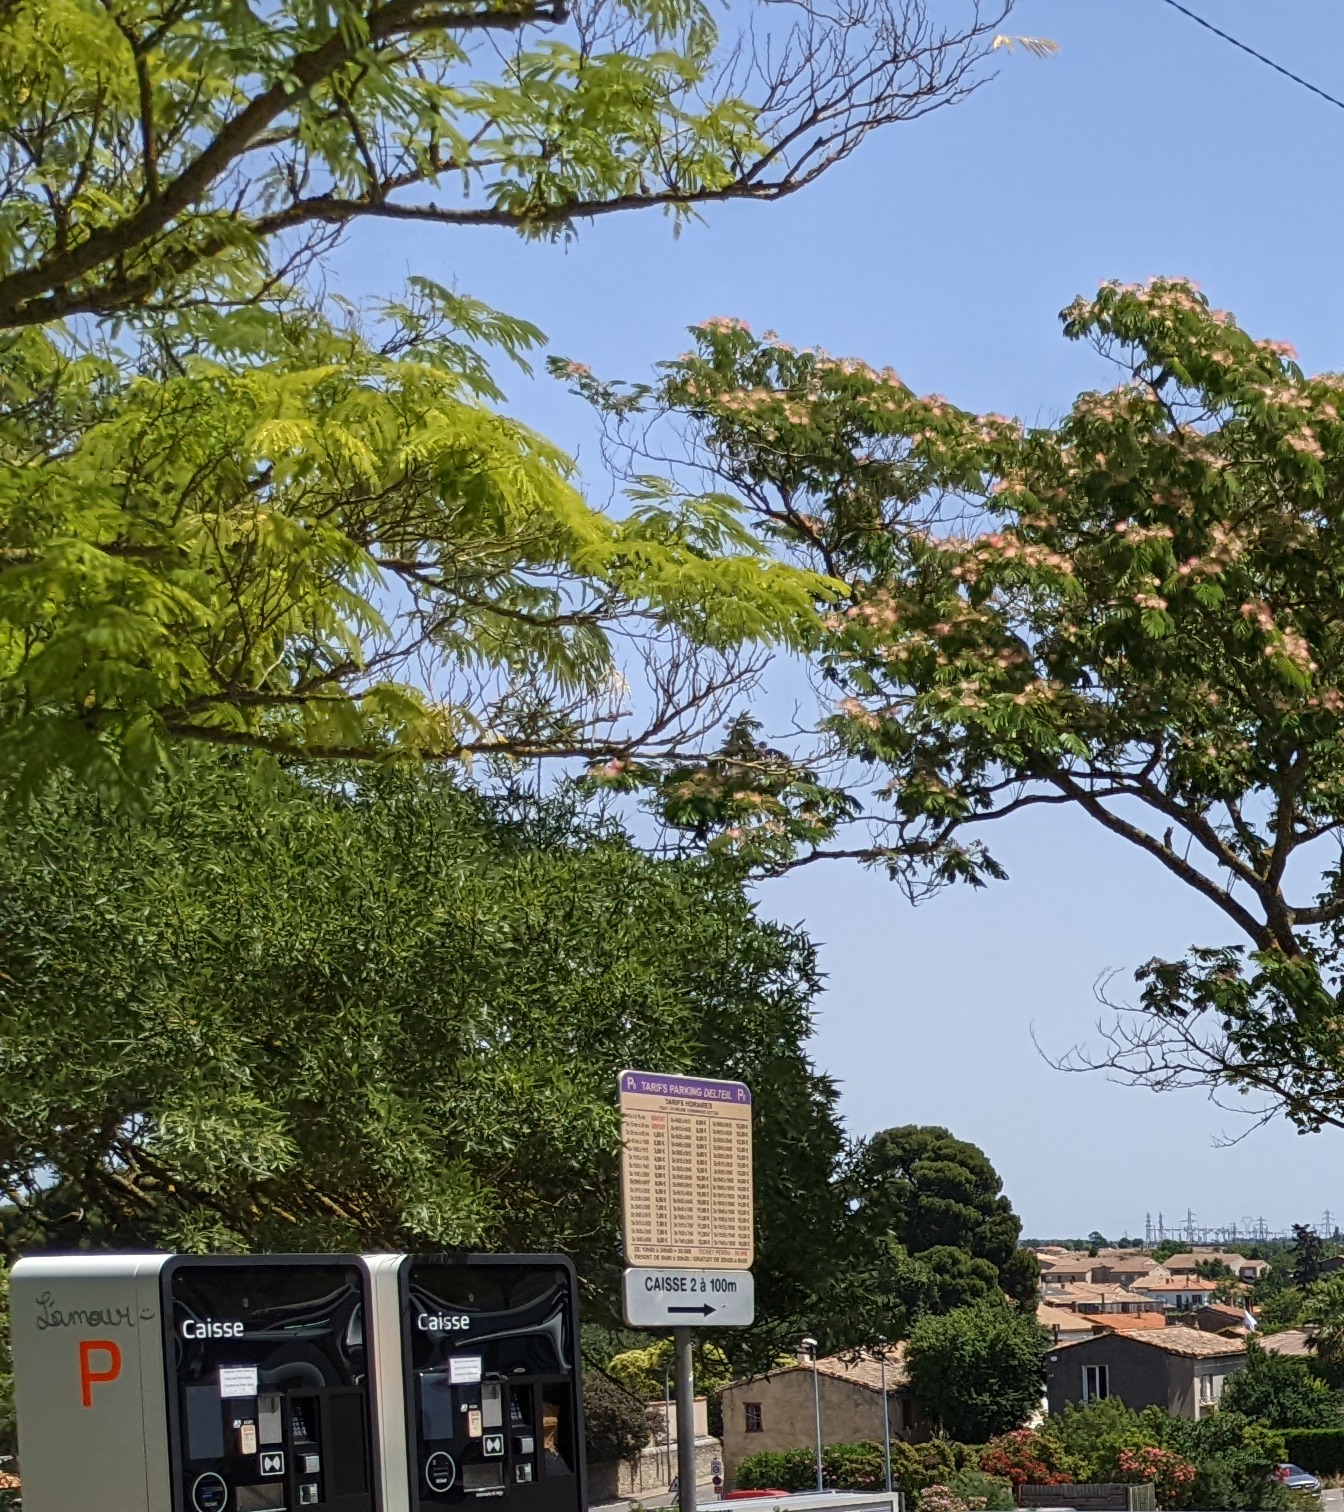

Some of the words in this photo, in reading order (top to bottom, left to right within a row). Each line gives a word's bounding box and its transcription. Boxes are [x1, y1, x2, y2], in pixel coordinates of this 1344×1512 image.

[641, 1081, 668, 1094] TARIFS
[669, 1084, 702, 1097] PARKING
[645, 1276, 688, 1292] CAISSE
[690, 1277, 697, 1292] 2
[700, 1277, 706, 1292] à
[710, 1278, 737, 1293] 100m
[182, 1318, 245, 1339] Caisse
[418, 1311, 470, 1331] Caisse
[79, 1339, 122, 1408] P
